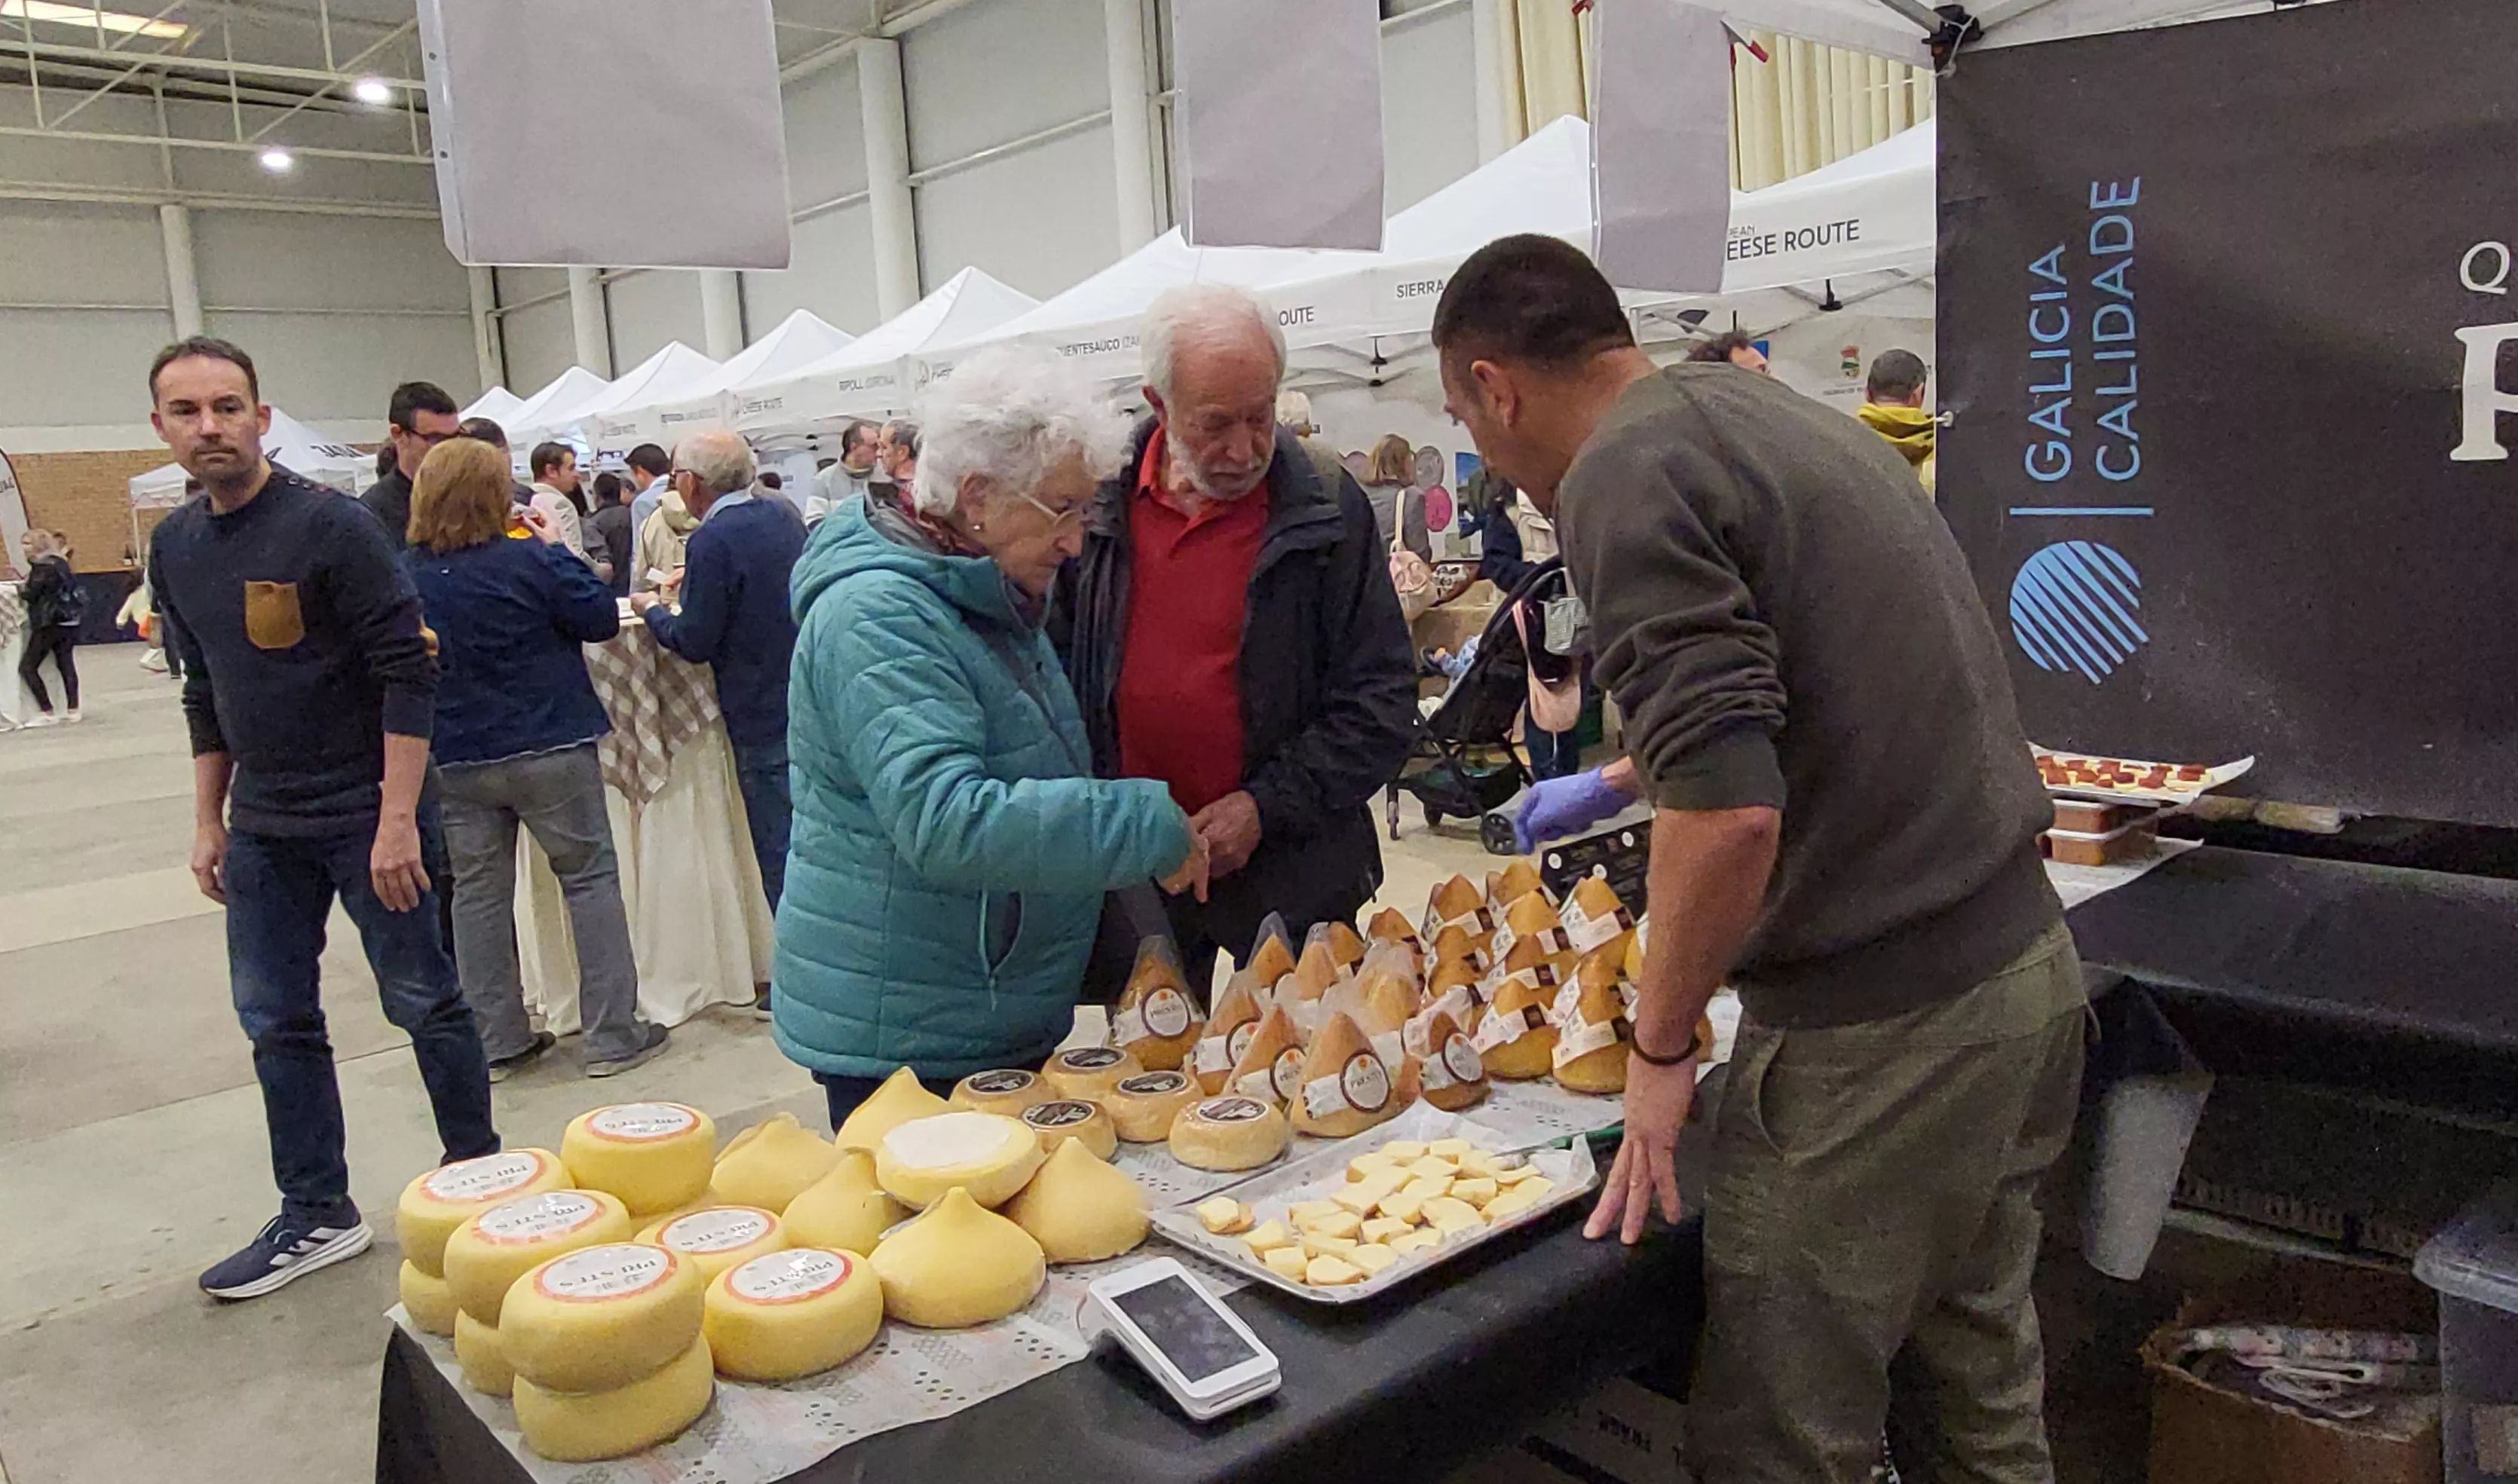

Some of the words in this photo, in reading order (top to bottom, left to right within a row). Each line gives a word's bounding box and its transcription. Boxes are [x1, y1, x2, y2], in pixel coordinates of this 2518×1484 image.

[1726, 233, 1778, 261] EESE
[1784, 219, 1861, 252] ROUTE
[1396, 279, 1444, 298] SIERRA
[1279, 306, 1316, 326] OUTE
[2089, 176, 2140, 482] CALIDADE
[2024, 243, 2072, 482] GALICIA
